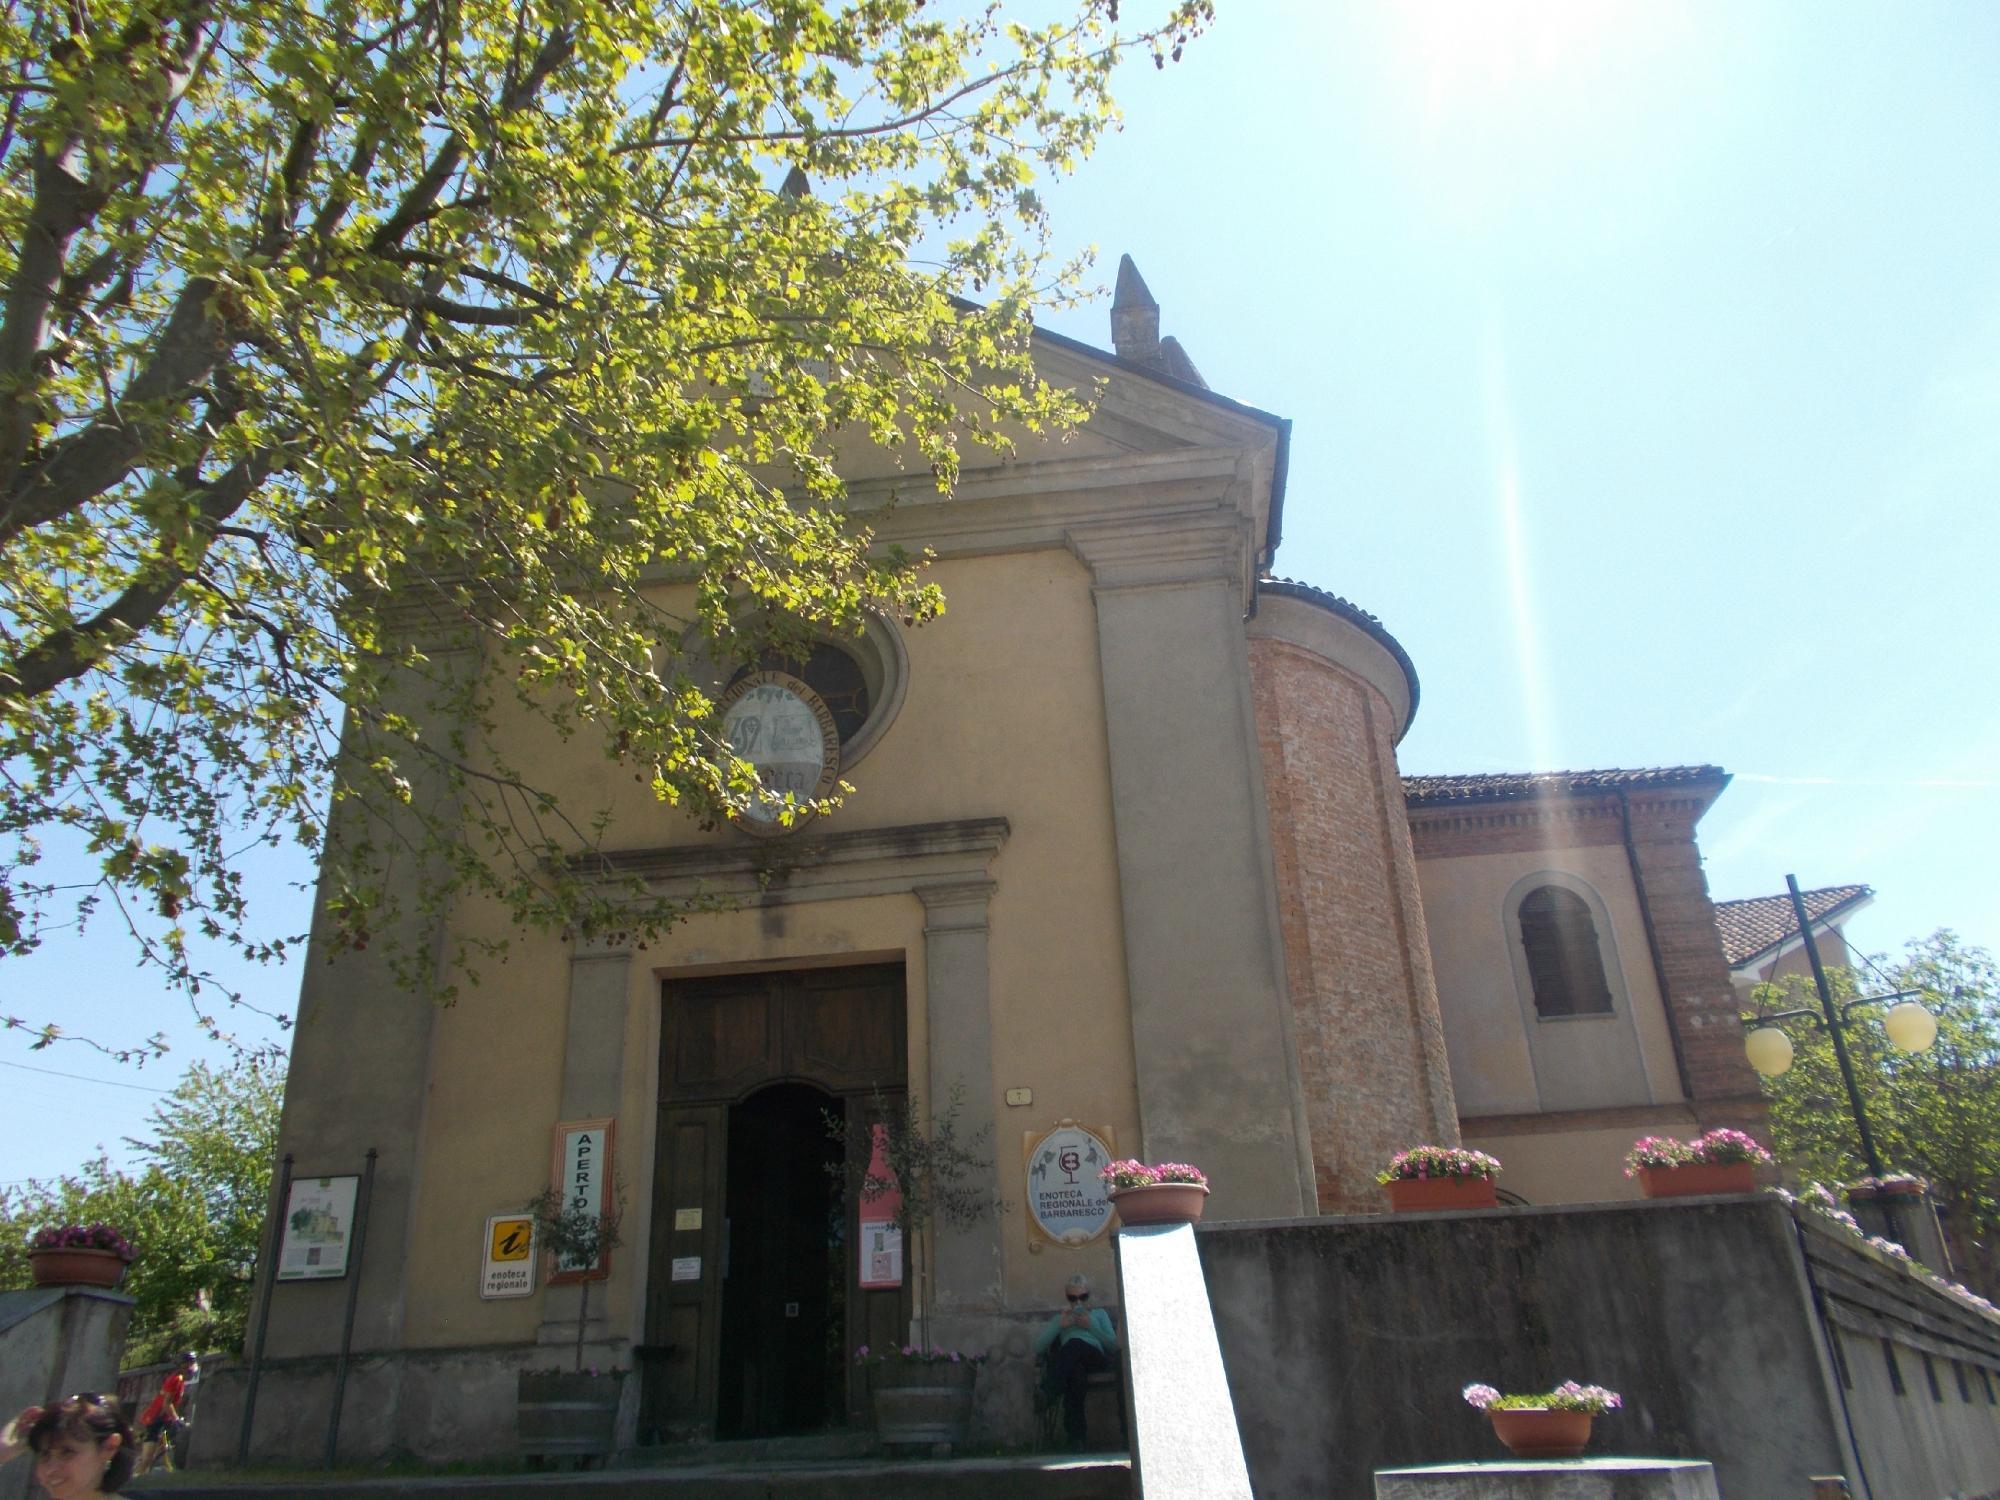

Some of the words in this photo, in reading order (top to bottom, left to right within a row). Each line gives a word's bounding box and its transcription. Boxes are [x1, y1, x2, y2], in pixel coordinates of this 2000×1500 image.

[786, 680, 807, 697] del
[807, 694, 838, 785] BARBARESCO
[574, 1133, 593, 1209] APERTO
[1039, 1190, 1083, 1201] ENOTECA
[1039, 1199, 1093, 1209] REGIONALE
[1040, 1207, 1105, 1219] BARBARESCO
[491, 1269, 526, 1279] enoteca
[487, 1280, 528, 1292] regionale
